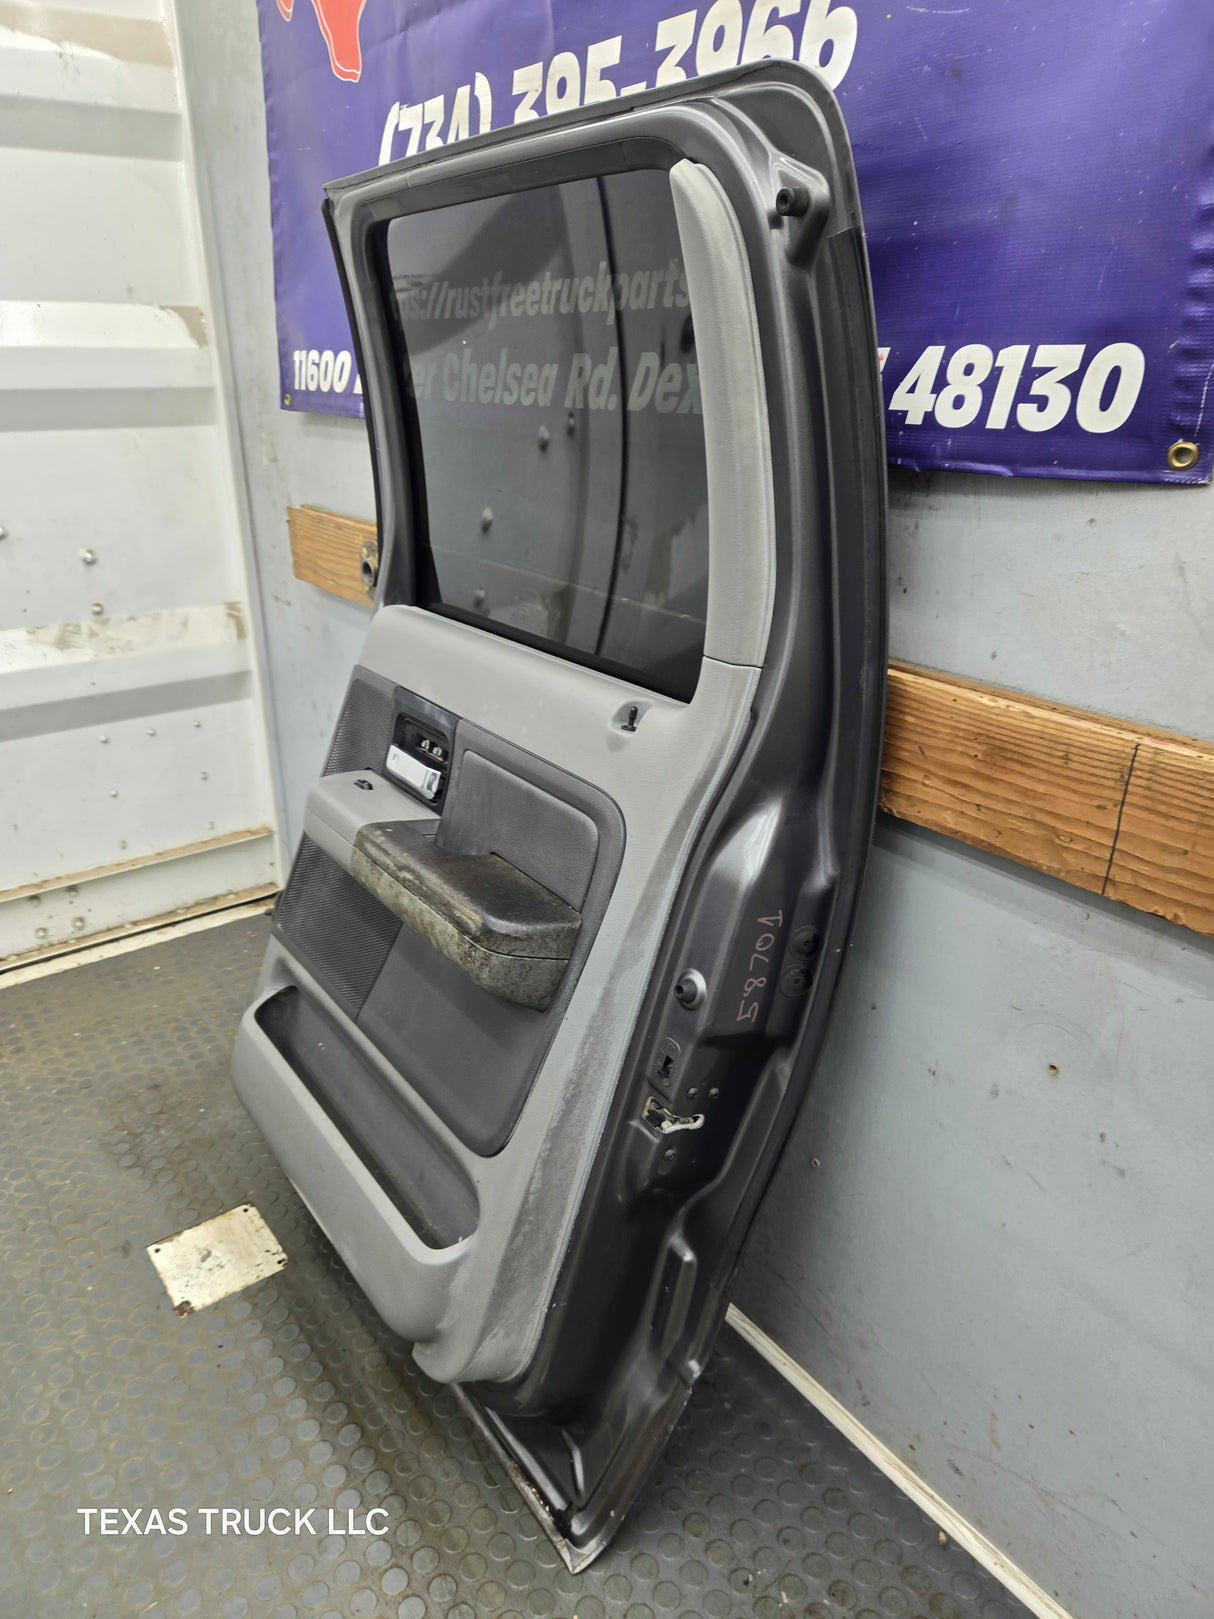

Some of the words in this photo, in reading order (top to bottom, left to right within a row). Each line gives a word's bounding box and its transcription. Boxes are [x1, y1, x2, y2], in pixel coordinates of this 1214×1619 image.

[378, 72, 492, 167] (734)
[512, 0, 858, 125] 395-3966
[293, 349, 352, 394] 11600
[442, 348, 559, 408] Chelsea
[564, 346, 618, 411] Rd.
[888, 342, 1146, 434] 48130
